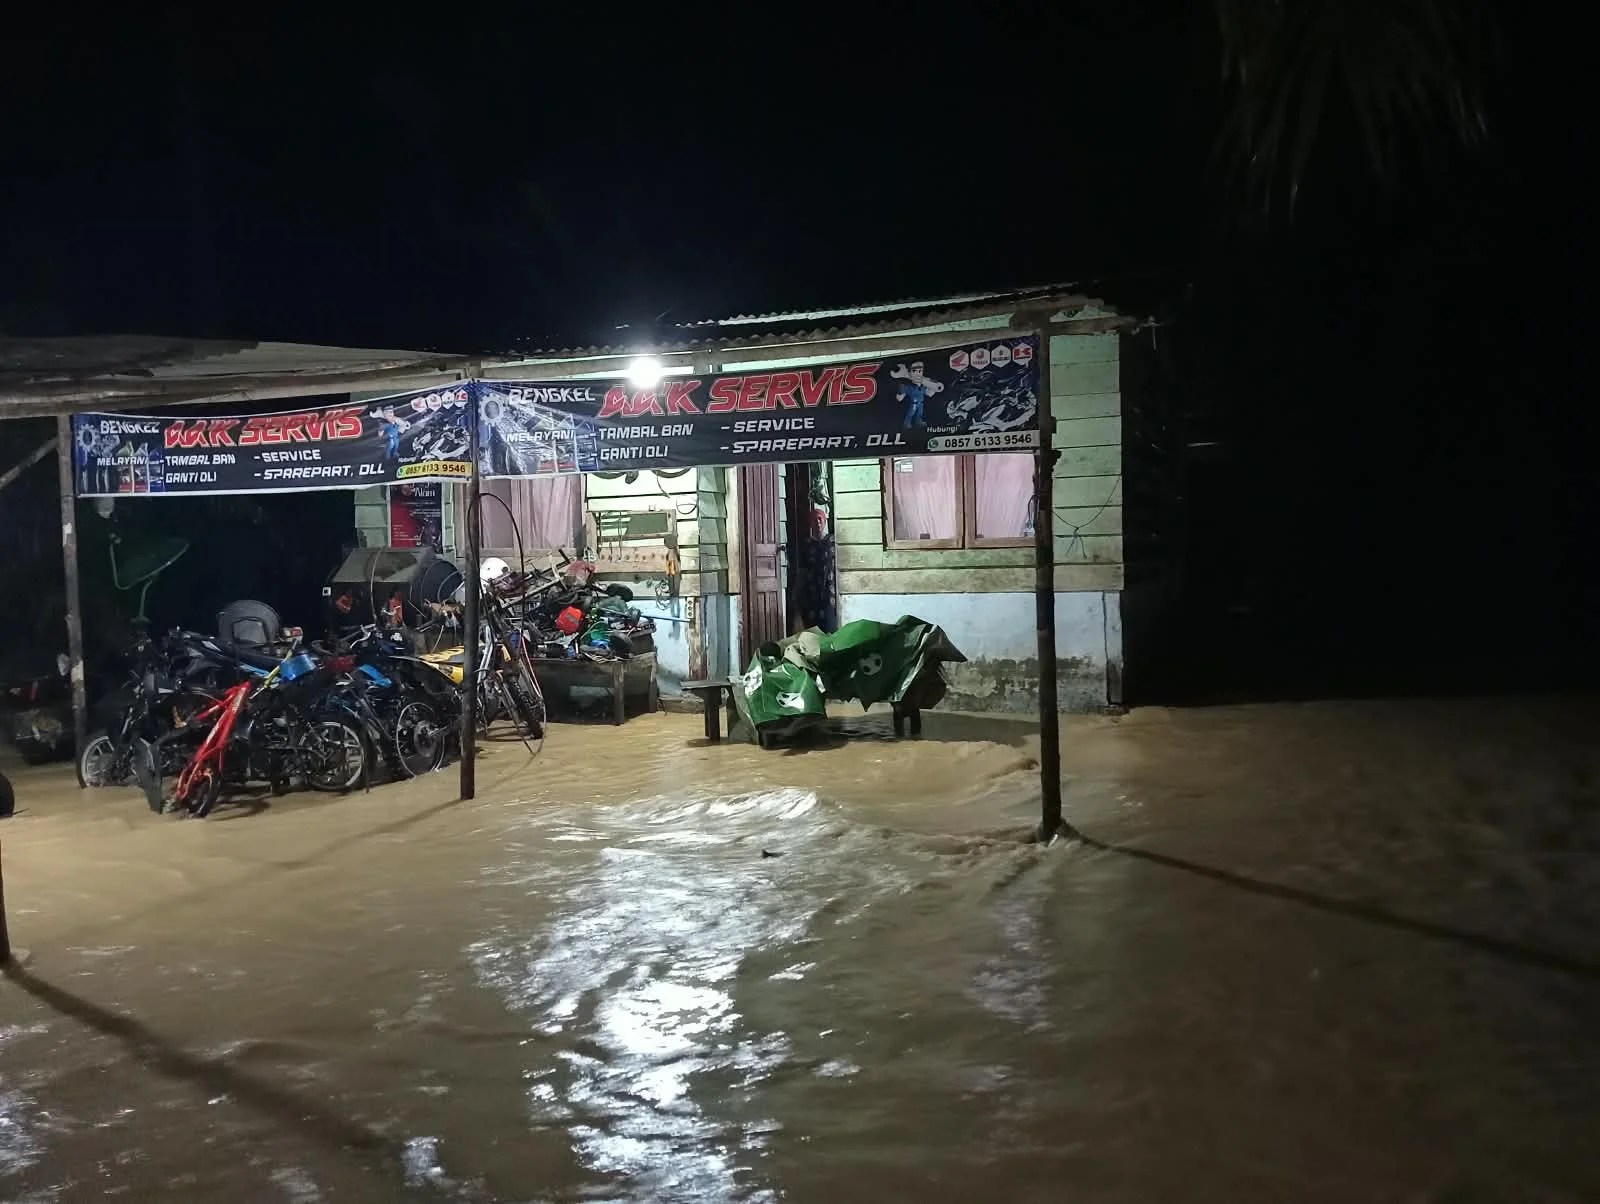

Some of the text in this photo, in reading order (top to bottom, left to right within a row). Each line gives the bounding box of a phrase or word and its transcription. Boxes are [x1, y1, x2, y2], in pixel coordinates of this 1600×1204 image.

[508, 387, 596, 405] BENGKEL
[705, 361, 882, 413] SERVIS
[506, 429, 574, 442] MELAYANI
[661, 423, 694, 437] BAN
[945, 434, 1032, 448] 0857 6133 9546
[645, 445, 668, 458] OLI
[97, 456, 148, 467] MELAYANI
[213, 453, 236, 465] BAN
[442, 463, 466, 473] 9546
[200, 471, 217, 483] OLI
